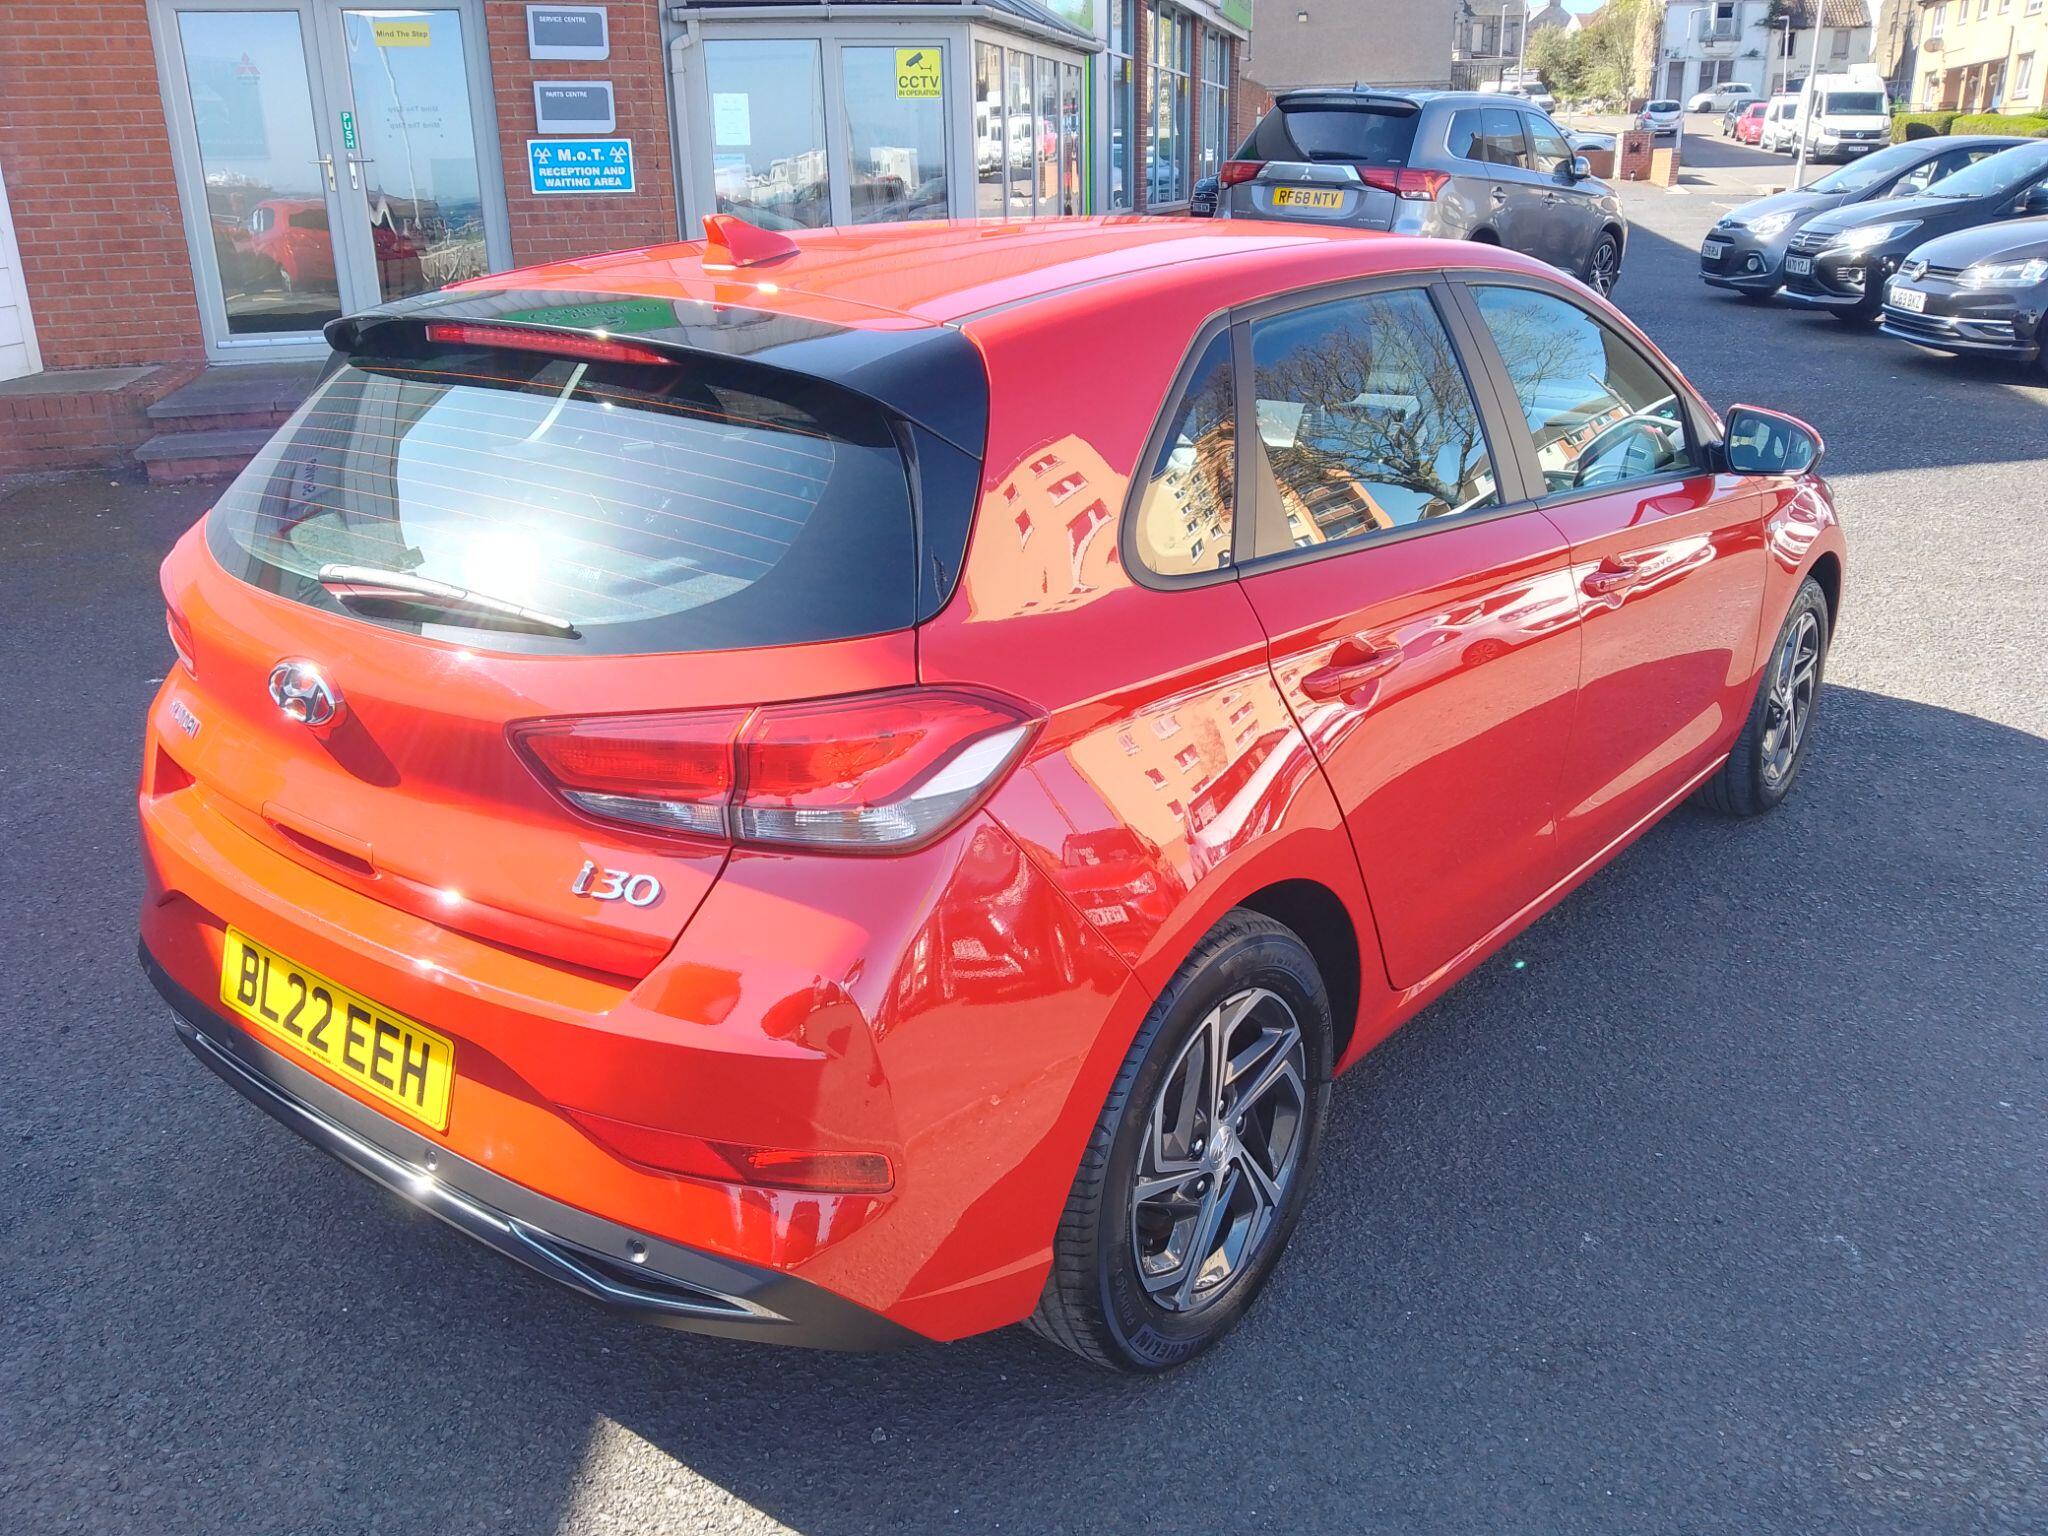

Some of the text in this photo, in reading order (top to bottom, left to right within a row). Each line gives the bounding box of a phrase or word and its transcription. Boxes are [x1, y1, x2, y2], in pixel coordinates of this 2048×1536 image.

[898, 76, 939, 88] CCTV
[342, 112, 354, 148] PUSH
[557, 149, 605, 161] M.o.T.
[539, 167, 625, 176] RECEPTION AND
[545, 178, 622, 187] WAITING AREA
[1278, 190, 1338, 206] RF68 NTV
[572, 860, 660, 906] i30
[237, 944, 430, 1107] BL22 EEH
